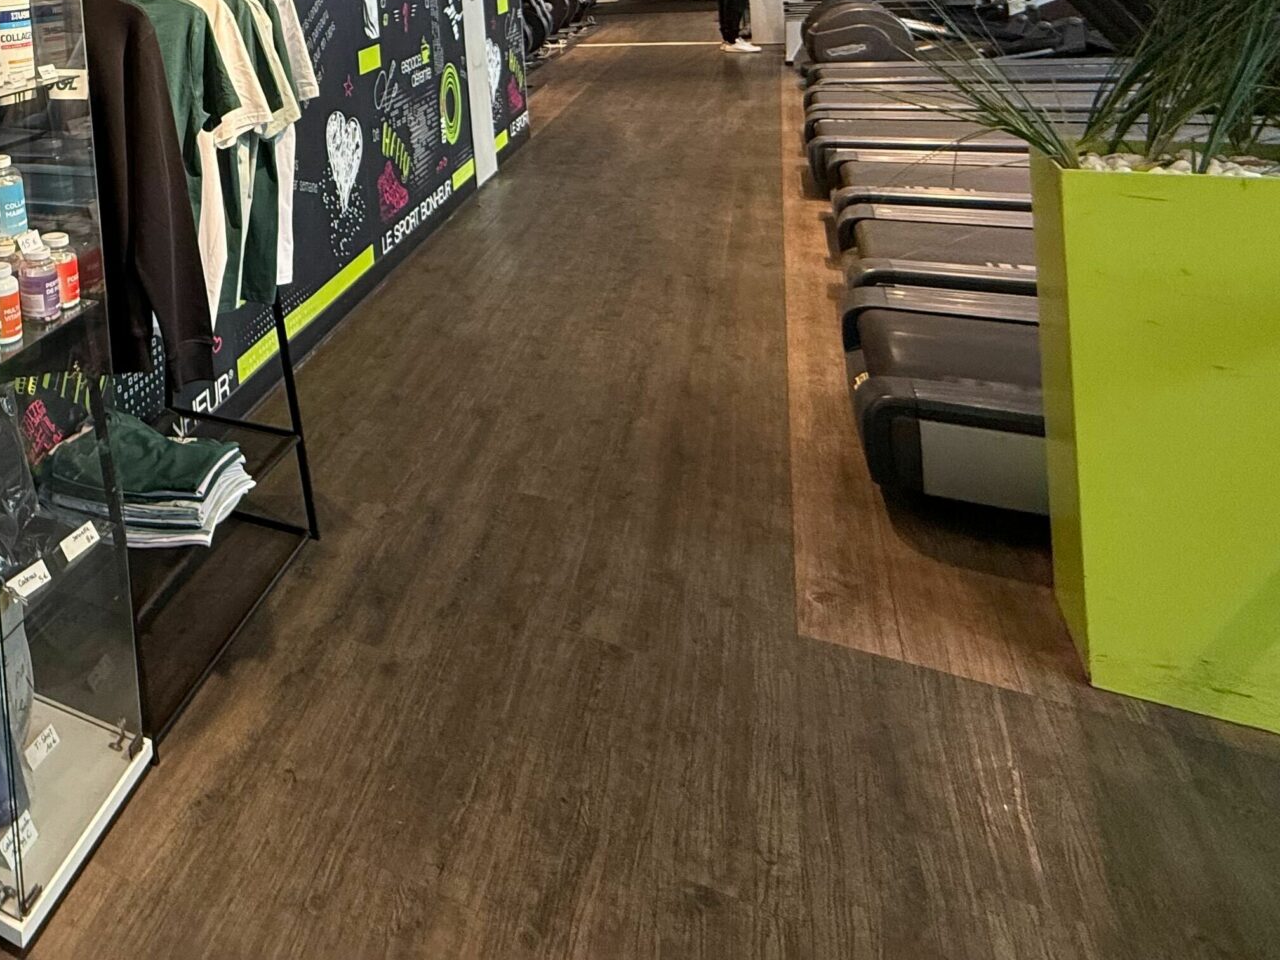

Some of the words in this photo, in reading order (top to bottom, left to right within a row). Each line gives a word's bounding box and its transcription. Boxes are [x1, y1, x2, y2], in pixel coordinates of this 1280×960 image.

[401, 53, 422, 75] espace
[380, 230, 394, 256] LE
[393, 206, 420, 244] SPORT
[420, 179, 453, 222] BONHEUR
